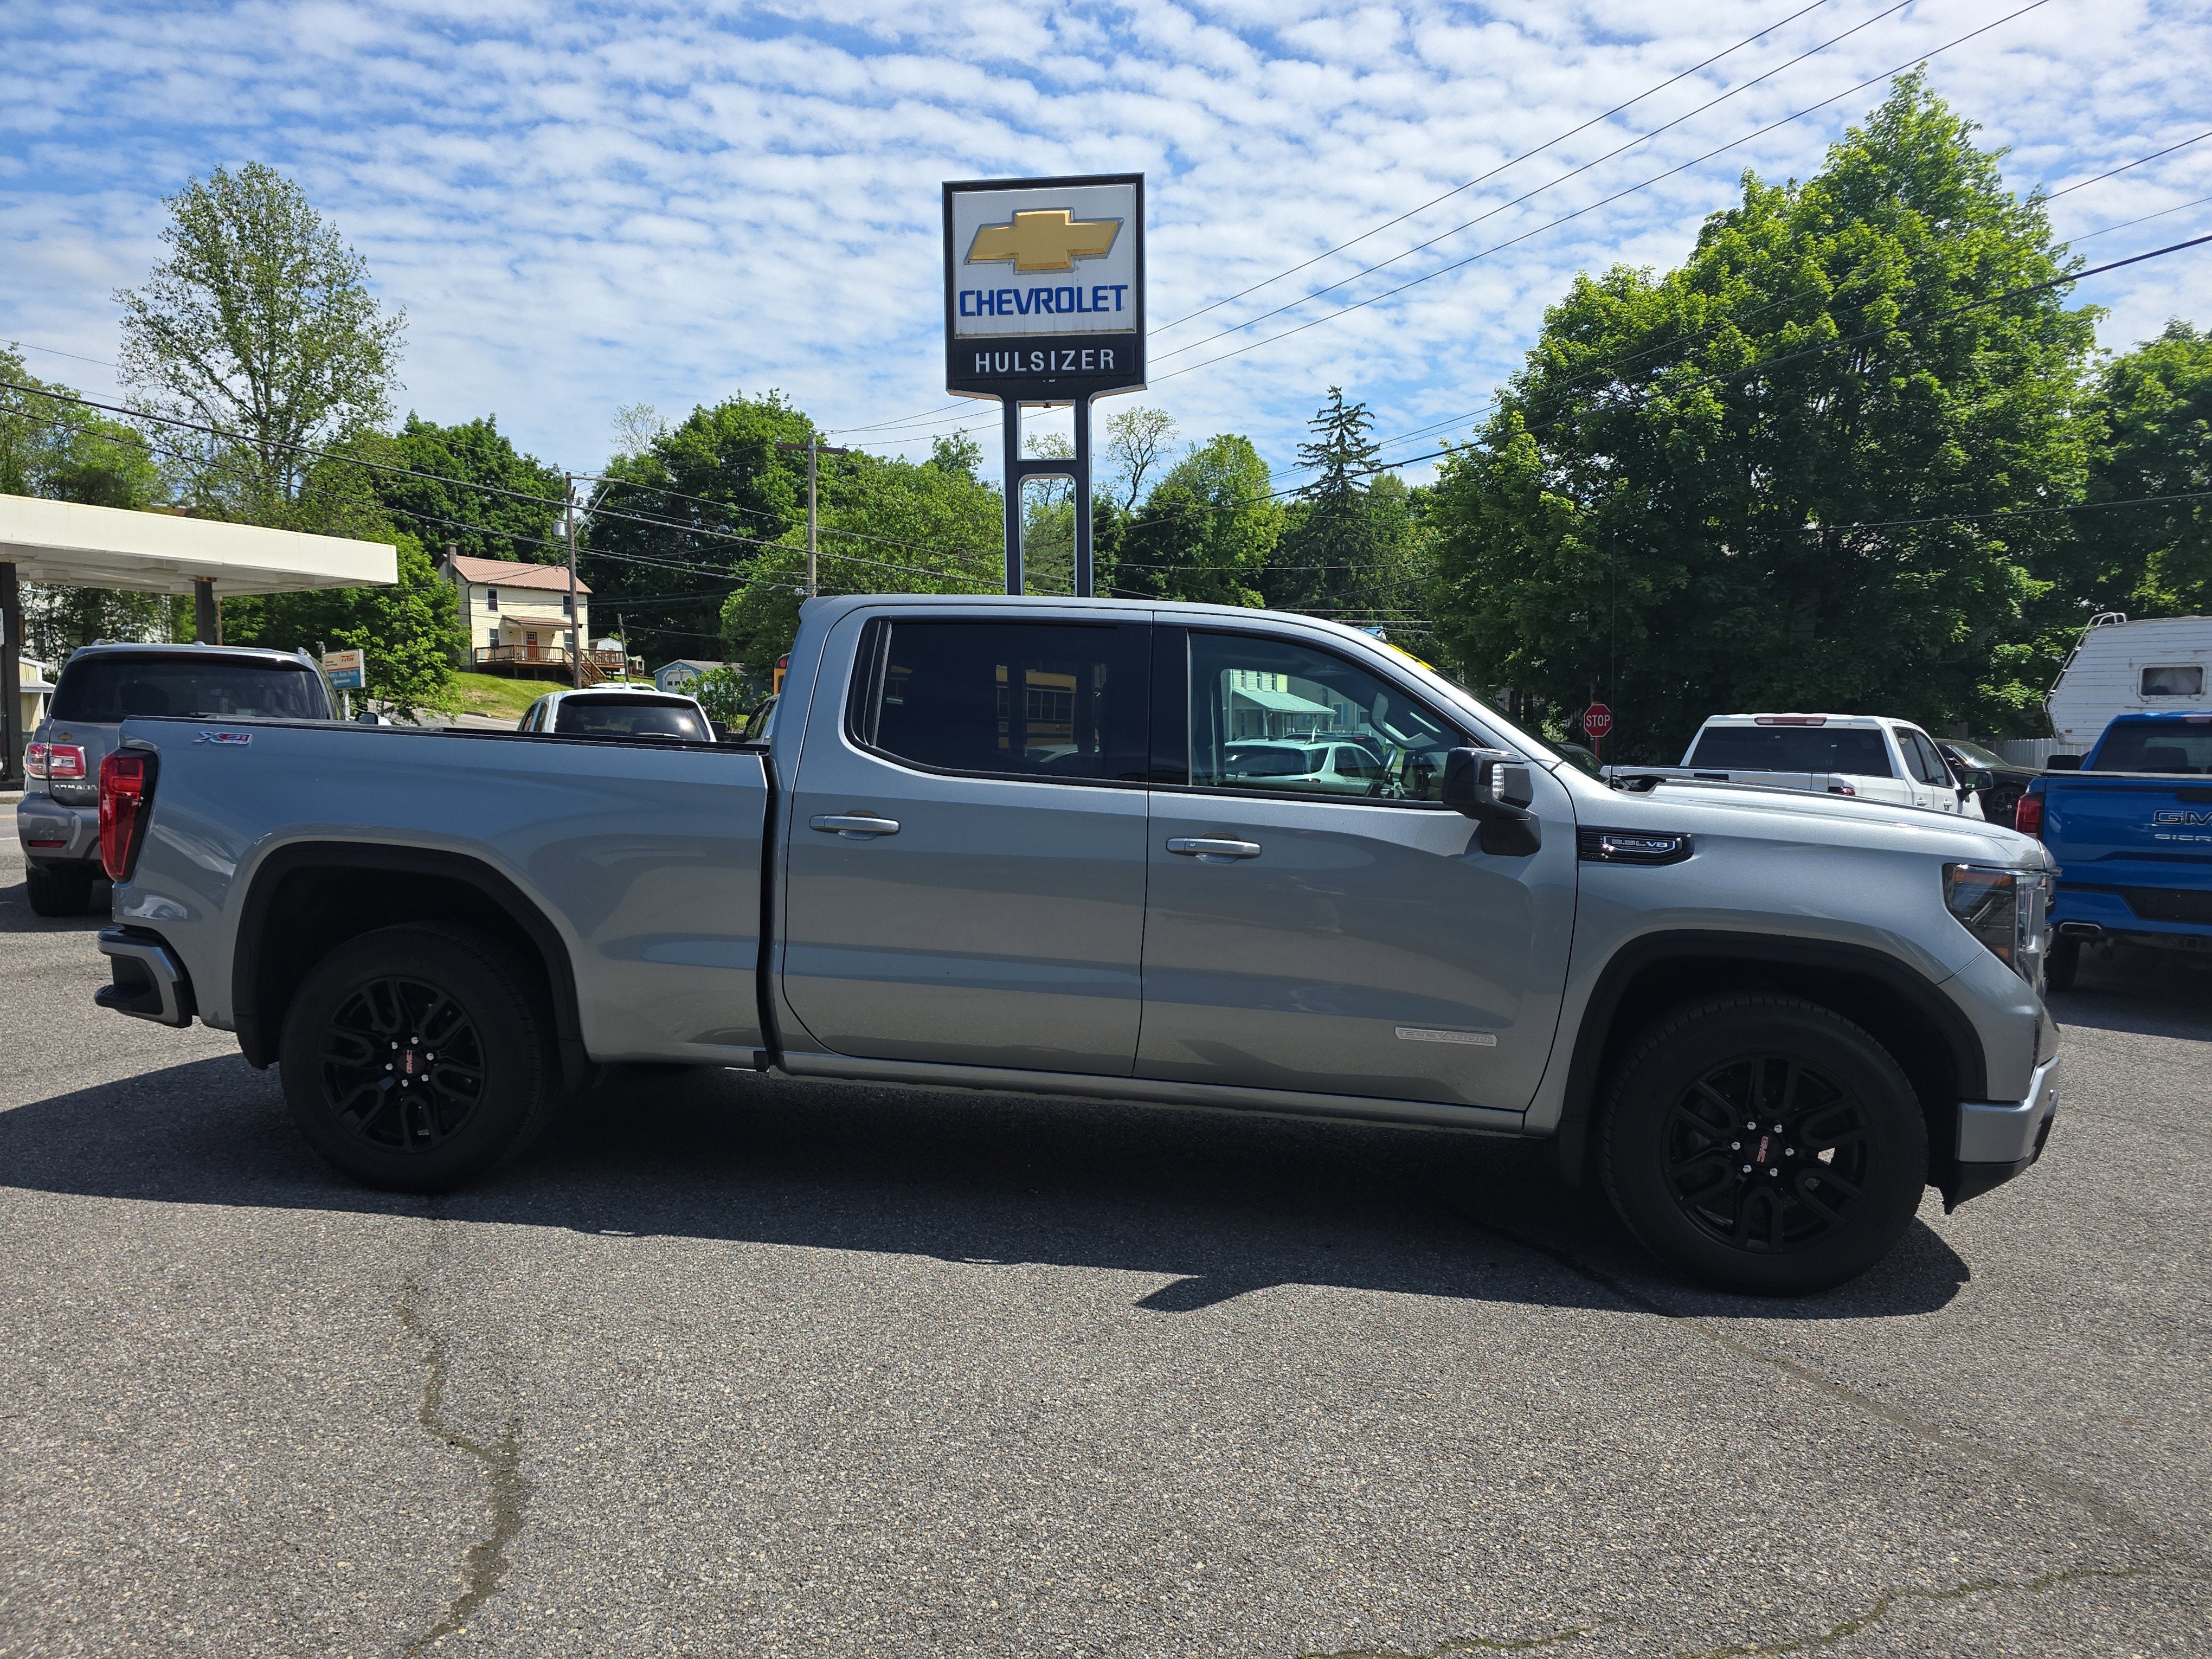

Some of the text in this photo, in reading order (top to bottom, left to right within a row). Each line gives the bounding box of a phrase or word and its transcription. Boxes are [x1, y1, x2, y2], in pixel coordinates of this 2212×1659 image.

[960, 285, 1128, 316] CHEVROLET
[976, 349, 1114, 373] HULSIZER
[1586, 715, 1610, 727] STOP
[1403, 1031, 1489, 1043] ELEVATION
[1757, 1136, 1769, 1162] GMC
